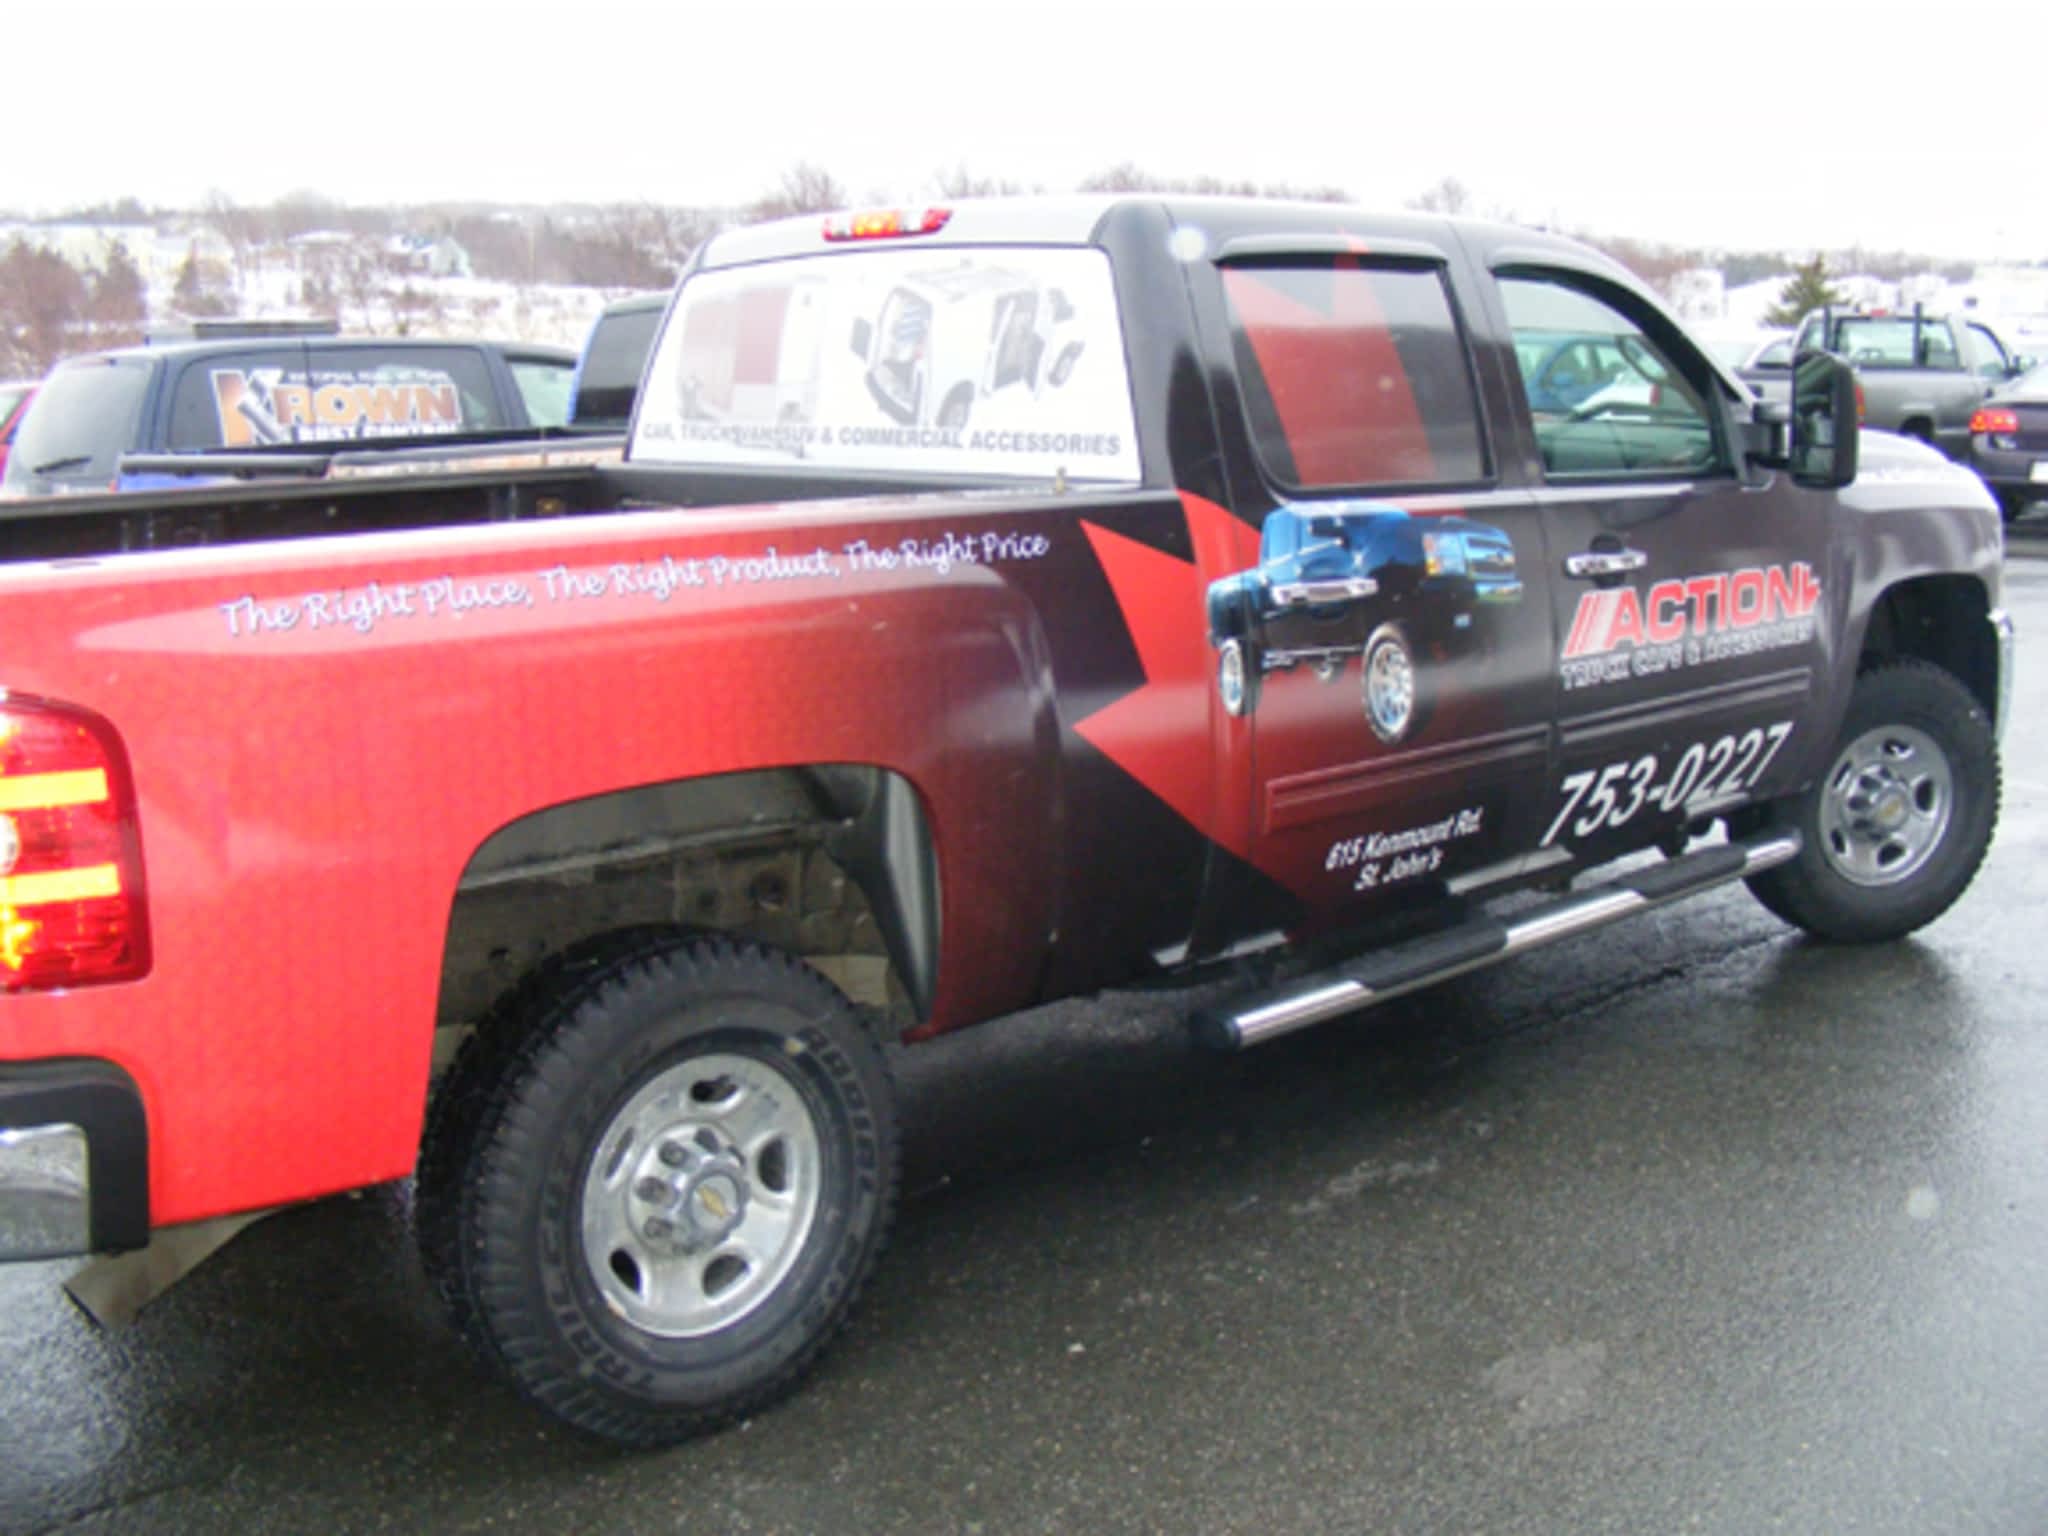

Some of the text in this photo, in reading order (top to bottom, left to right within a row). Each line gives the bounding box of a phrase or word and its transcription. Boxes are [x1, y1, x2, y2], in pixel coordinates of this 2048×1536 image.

[820, 426, 833, 444] &
[838, 426, 963, 449] COMMERCIAL
[969, 430, 1121, 456] ACCESSORIES
[219, 531, 1051, 636] The Right Place, The Right Product, The Right Price
[1603, 561, 1815, 650] ACTION
[1560, 653, 1632, 691] TRUCK
[1539, 719, 1794, 848] 753-0227
